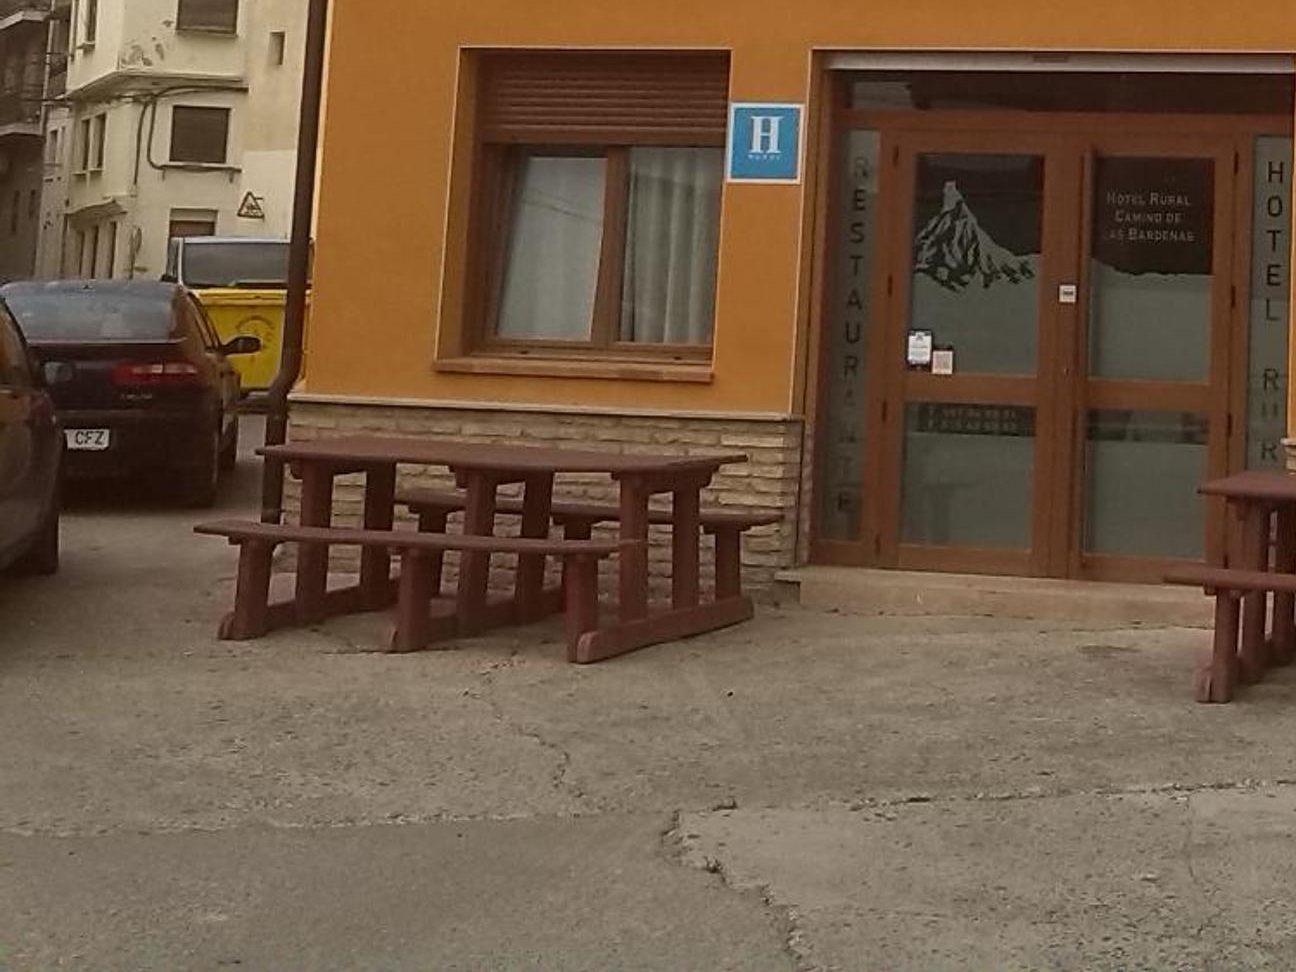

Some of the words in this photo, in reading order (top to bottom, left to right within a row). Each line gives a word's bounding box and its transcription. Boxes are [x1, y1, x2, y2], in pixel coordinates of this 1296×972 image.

[748, 116, 784, 153] H
[1265, 161, 1285, 321] HOTEL
[75, 430, 104, 446] CFZ
